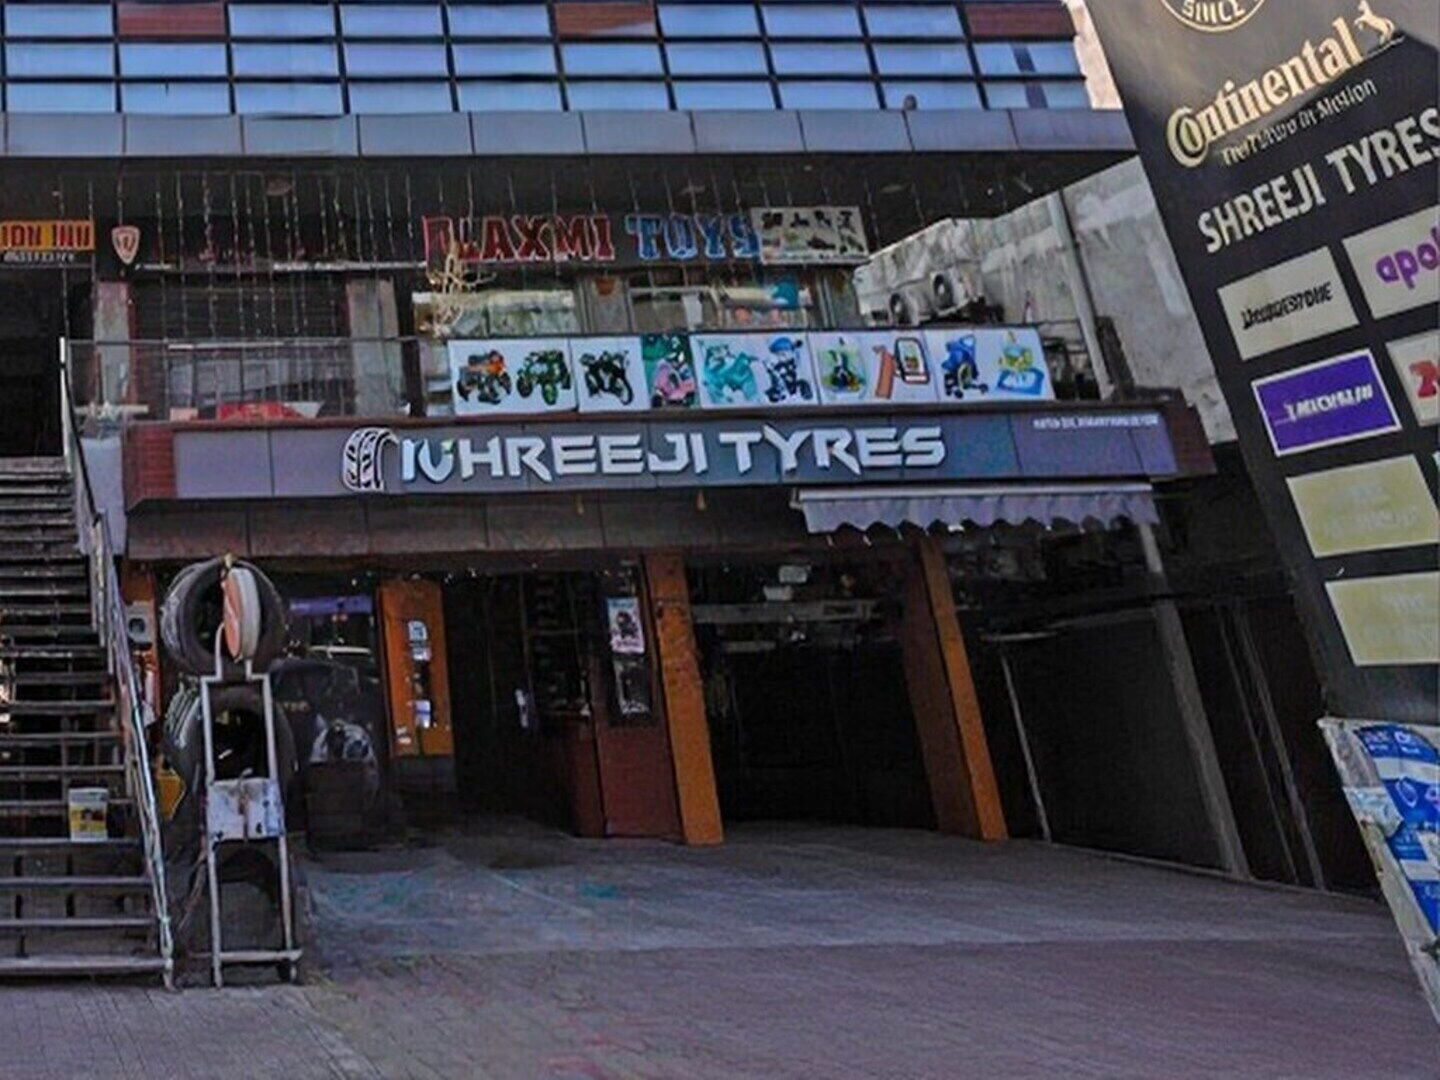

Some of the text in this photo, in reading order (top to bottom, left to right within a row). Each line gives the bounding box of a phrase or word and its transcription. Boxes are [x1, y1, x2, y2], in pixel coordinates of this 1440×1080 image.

[1166, 16, 1365, 168] Continental
[1198, 108, 1440, 254] SHREEJI TYRES
[626, 214, 760, 261] TOYS
[719, 425, 946, 476] TYRES
